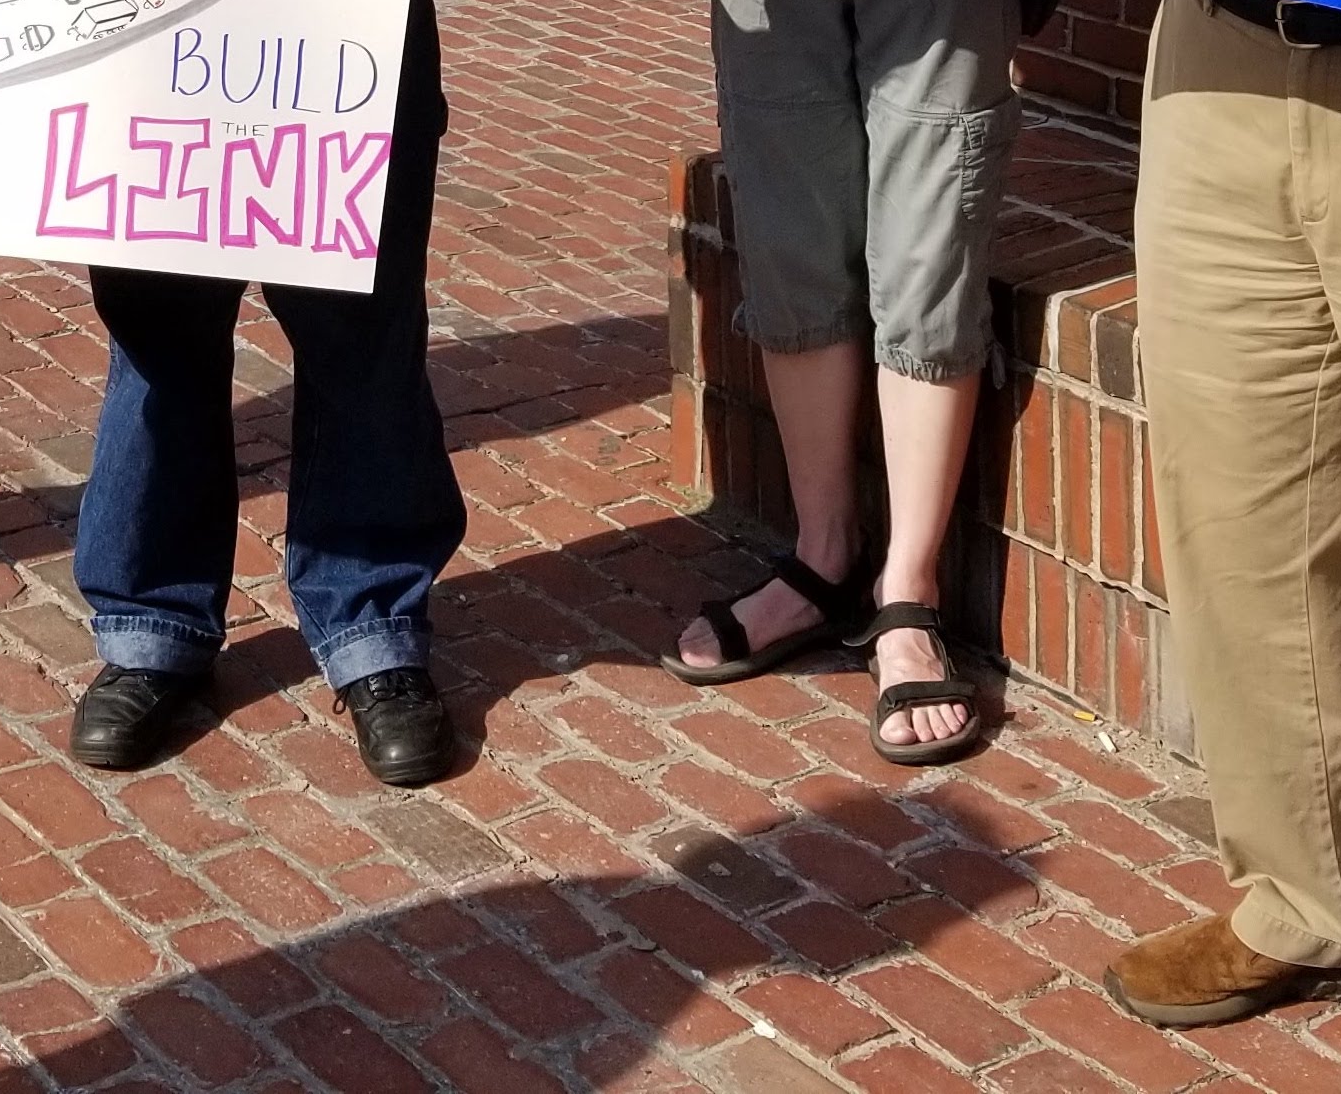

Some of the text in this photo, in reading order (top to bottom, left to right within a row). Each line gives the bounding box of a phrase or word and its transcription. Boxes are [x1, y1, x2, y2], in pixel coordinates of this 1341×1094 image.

[171, 27, 379, 114] BUILD
[221, 121, 270, 137] THE
[35, 102, 392, 260] LINK
